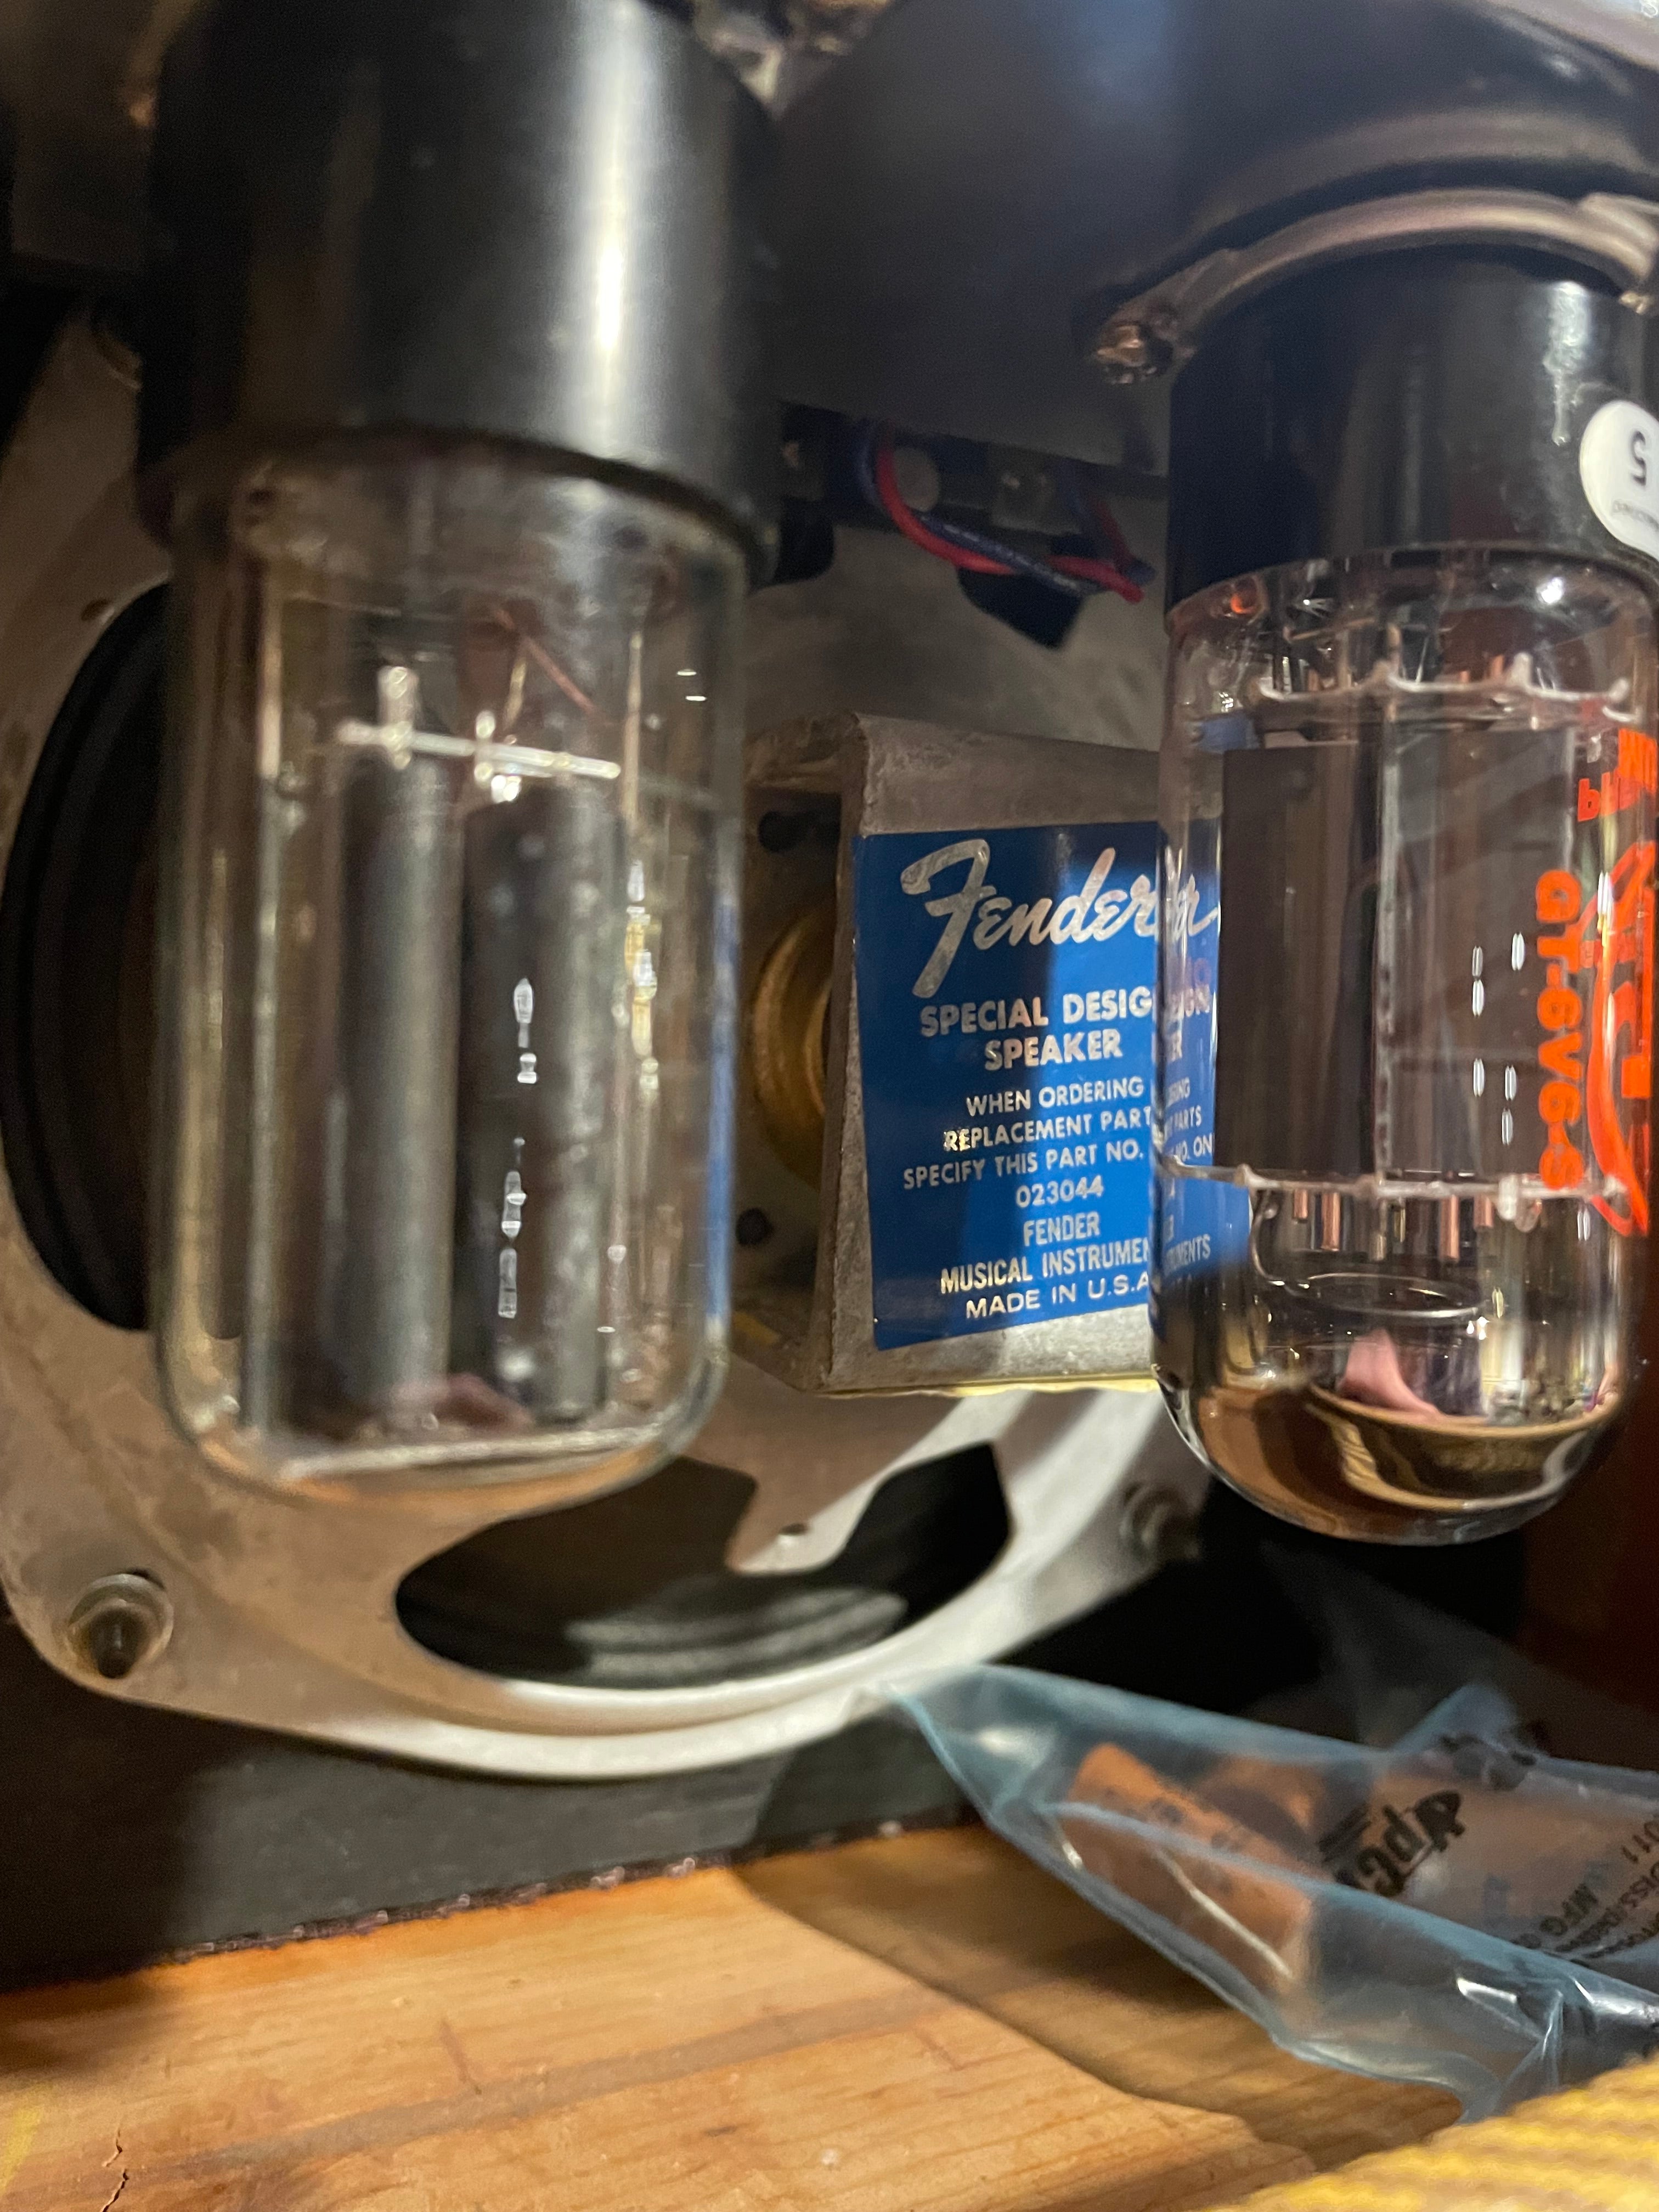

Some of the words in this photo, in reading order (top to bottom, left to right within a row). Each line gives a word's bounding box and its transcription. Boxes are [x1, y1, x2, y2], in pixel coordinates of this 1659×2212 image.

[900, 839, 1157, 998] Fender
[920, 997, 1048, 1037] SPECIAL
[1062, 986, 1153, 1024] DESIG
[984, 1029, 1122, 1071] SPEAKER
[966, 1089, 1031, 1116] WHEN
[1039, 1076, 1144, 1107] ORDERING
[943, 1114, 1092, 1152] REPLACEMENT
[1101, 1107, 1152, 1131] PART
[904, 1158, 985, 1189] SPECIFY
[995, 1153, 1038, 1177] THIS
[1046, 1146, 1101, 1169] PART
[1106, 1139, 1143, 1161] NO.
[1015, 1175, 1104, 1207] 023044
[1023, 1211, 1101, 1247] FENDER
[940, 1258, 1032, 1294] MUSICAL
[966, 1289, 1040, 1319] MADE
[1052, 1283, 1076, 1304] IN
